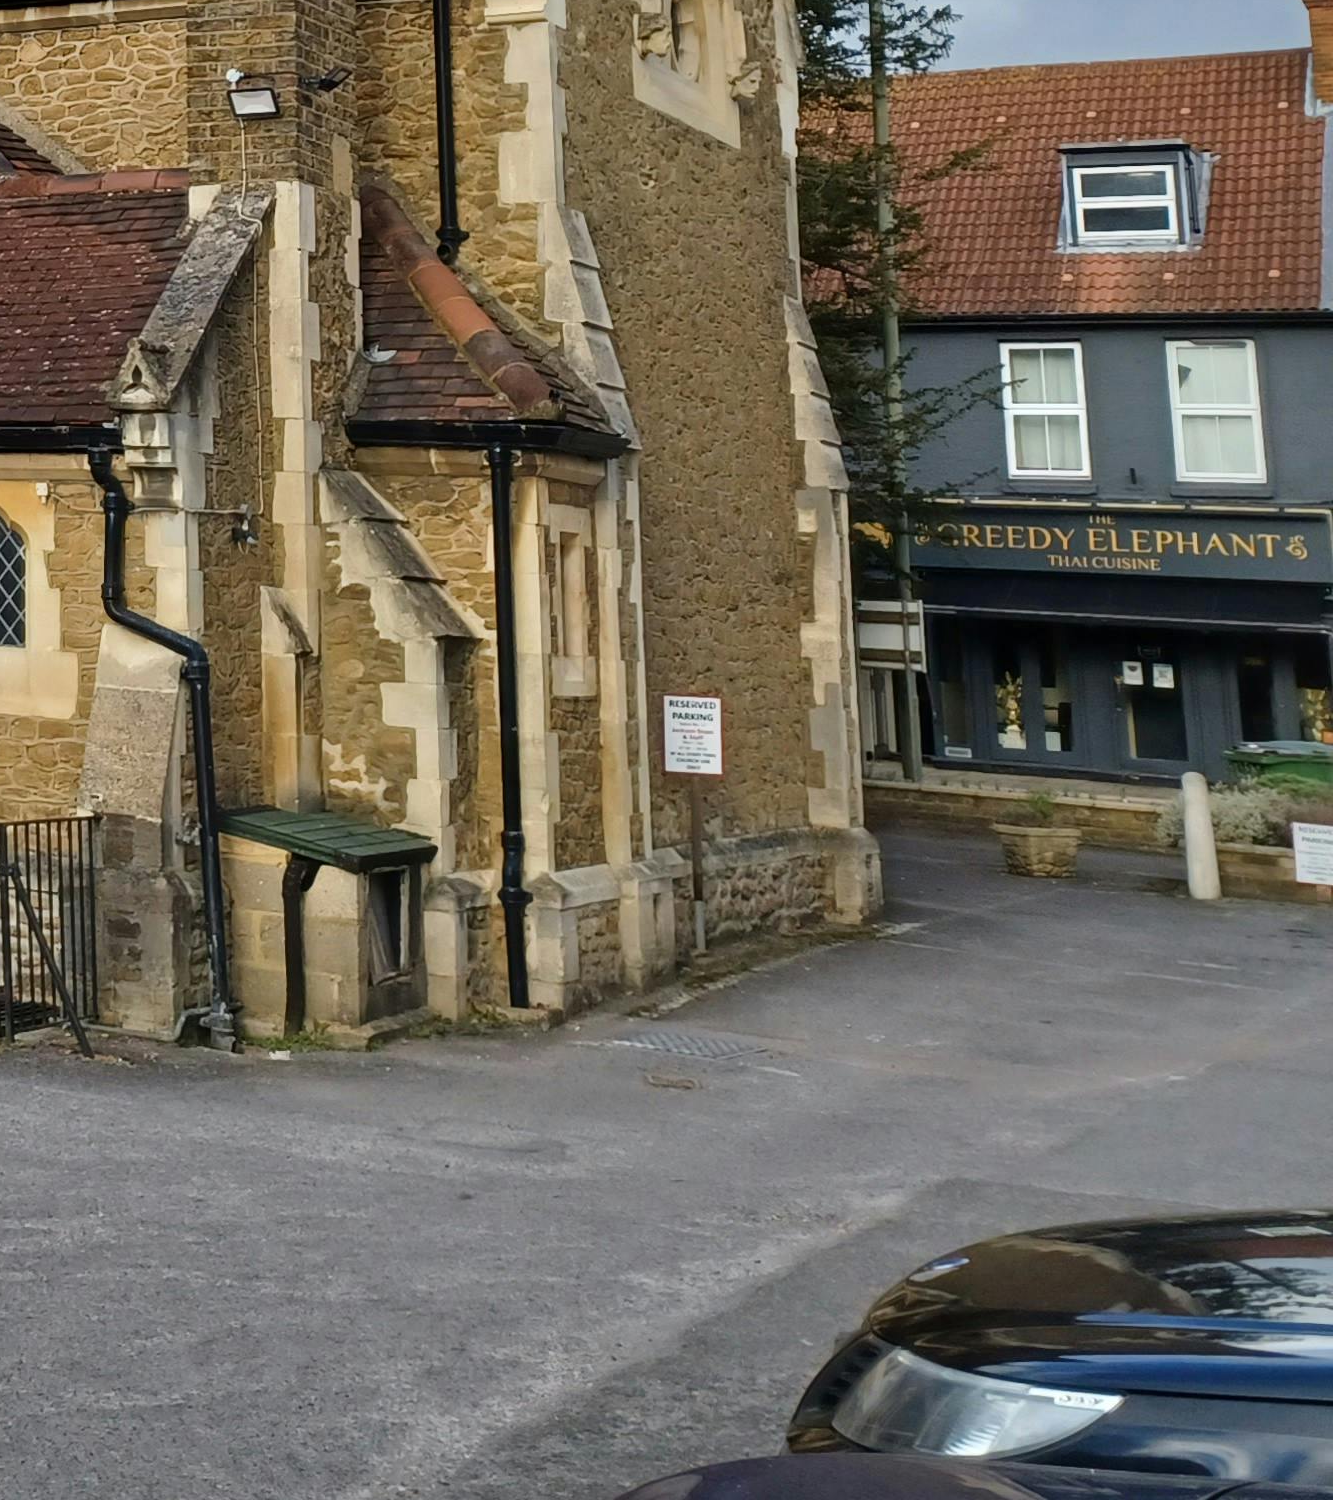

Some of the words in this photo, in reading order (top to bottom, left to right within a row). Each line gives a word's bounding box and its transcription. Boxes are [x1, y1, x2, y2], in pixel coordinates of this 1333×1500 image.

[1086, 528, 1281, 558] ELEPHANT
[1047, 554, 1088, 568] THAI
[1092, 556, 1161, 571] CUISINE
[669, 700, 717, 710] RESERVED
[672, 712, 714, 722] PARKING
